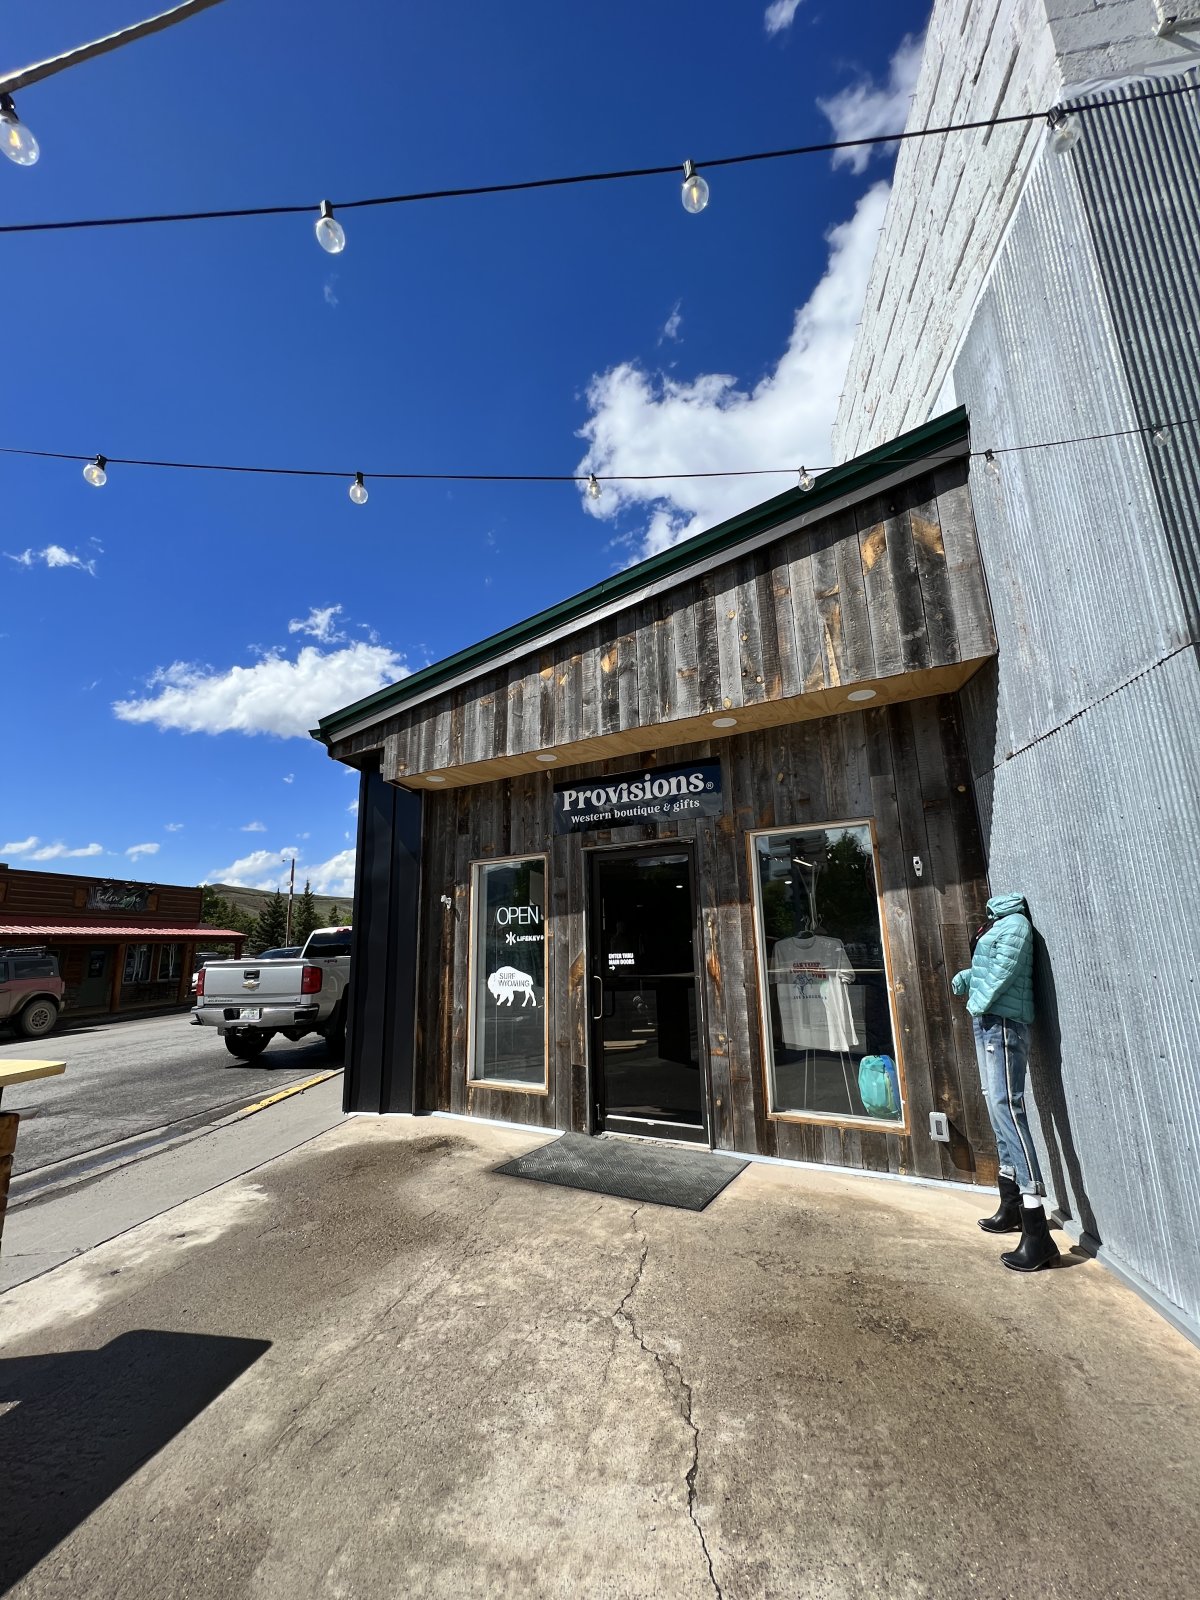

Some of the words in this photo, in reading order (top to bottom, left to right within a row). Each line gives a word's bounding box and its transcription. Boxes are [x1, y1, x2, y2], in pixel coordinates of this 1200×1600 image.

[571, 812, 612, 824] Western
[614, 804, 661, 818] boutique
[663, 803, 671, 812] &
[673, 798, 700, 812] gifts
[496, 906, 539, 925] OPEN
[499, 972, 516, 980] SURF
[498, 980, 530, 988] WYOMING
